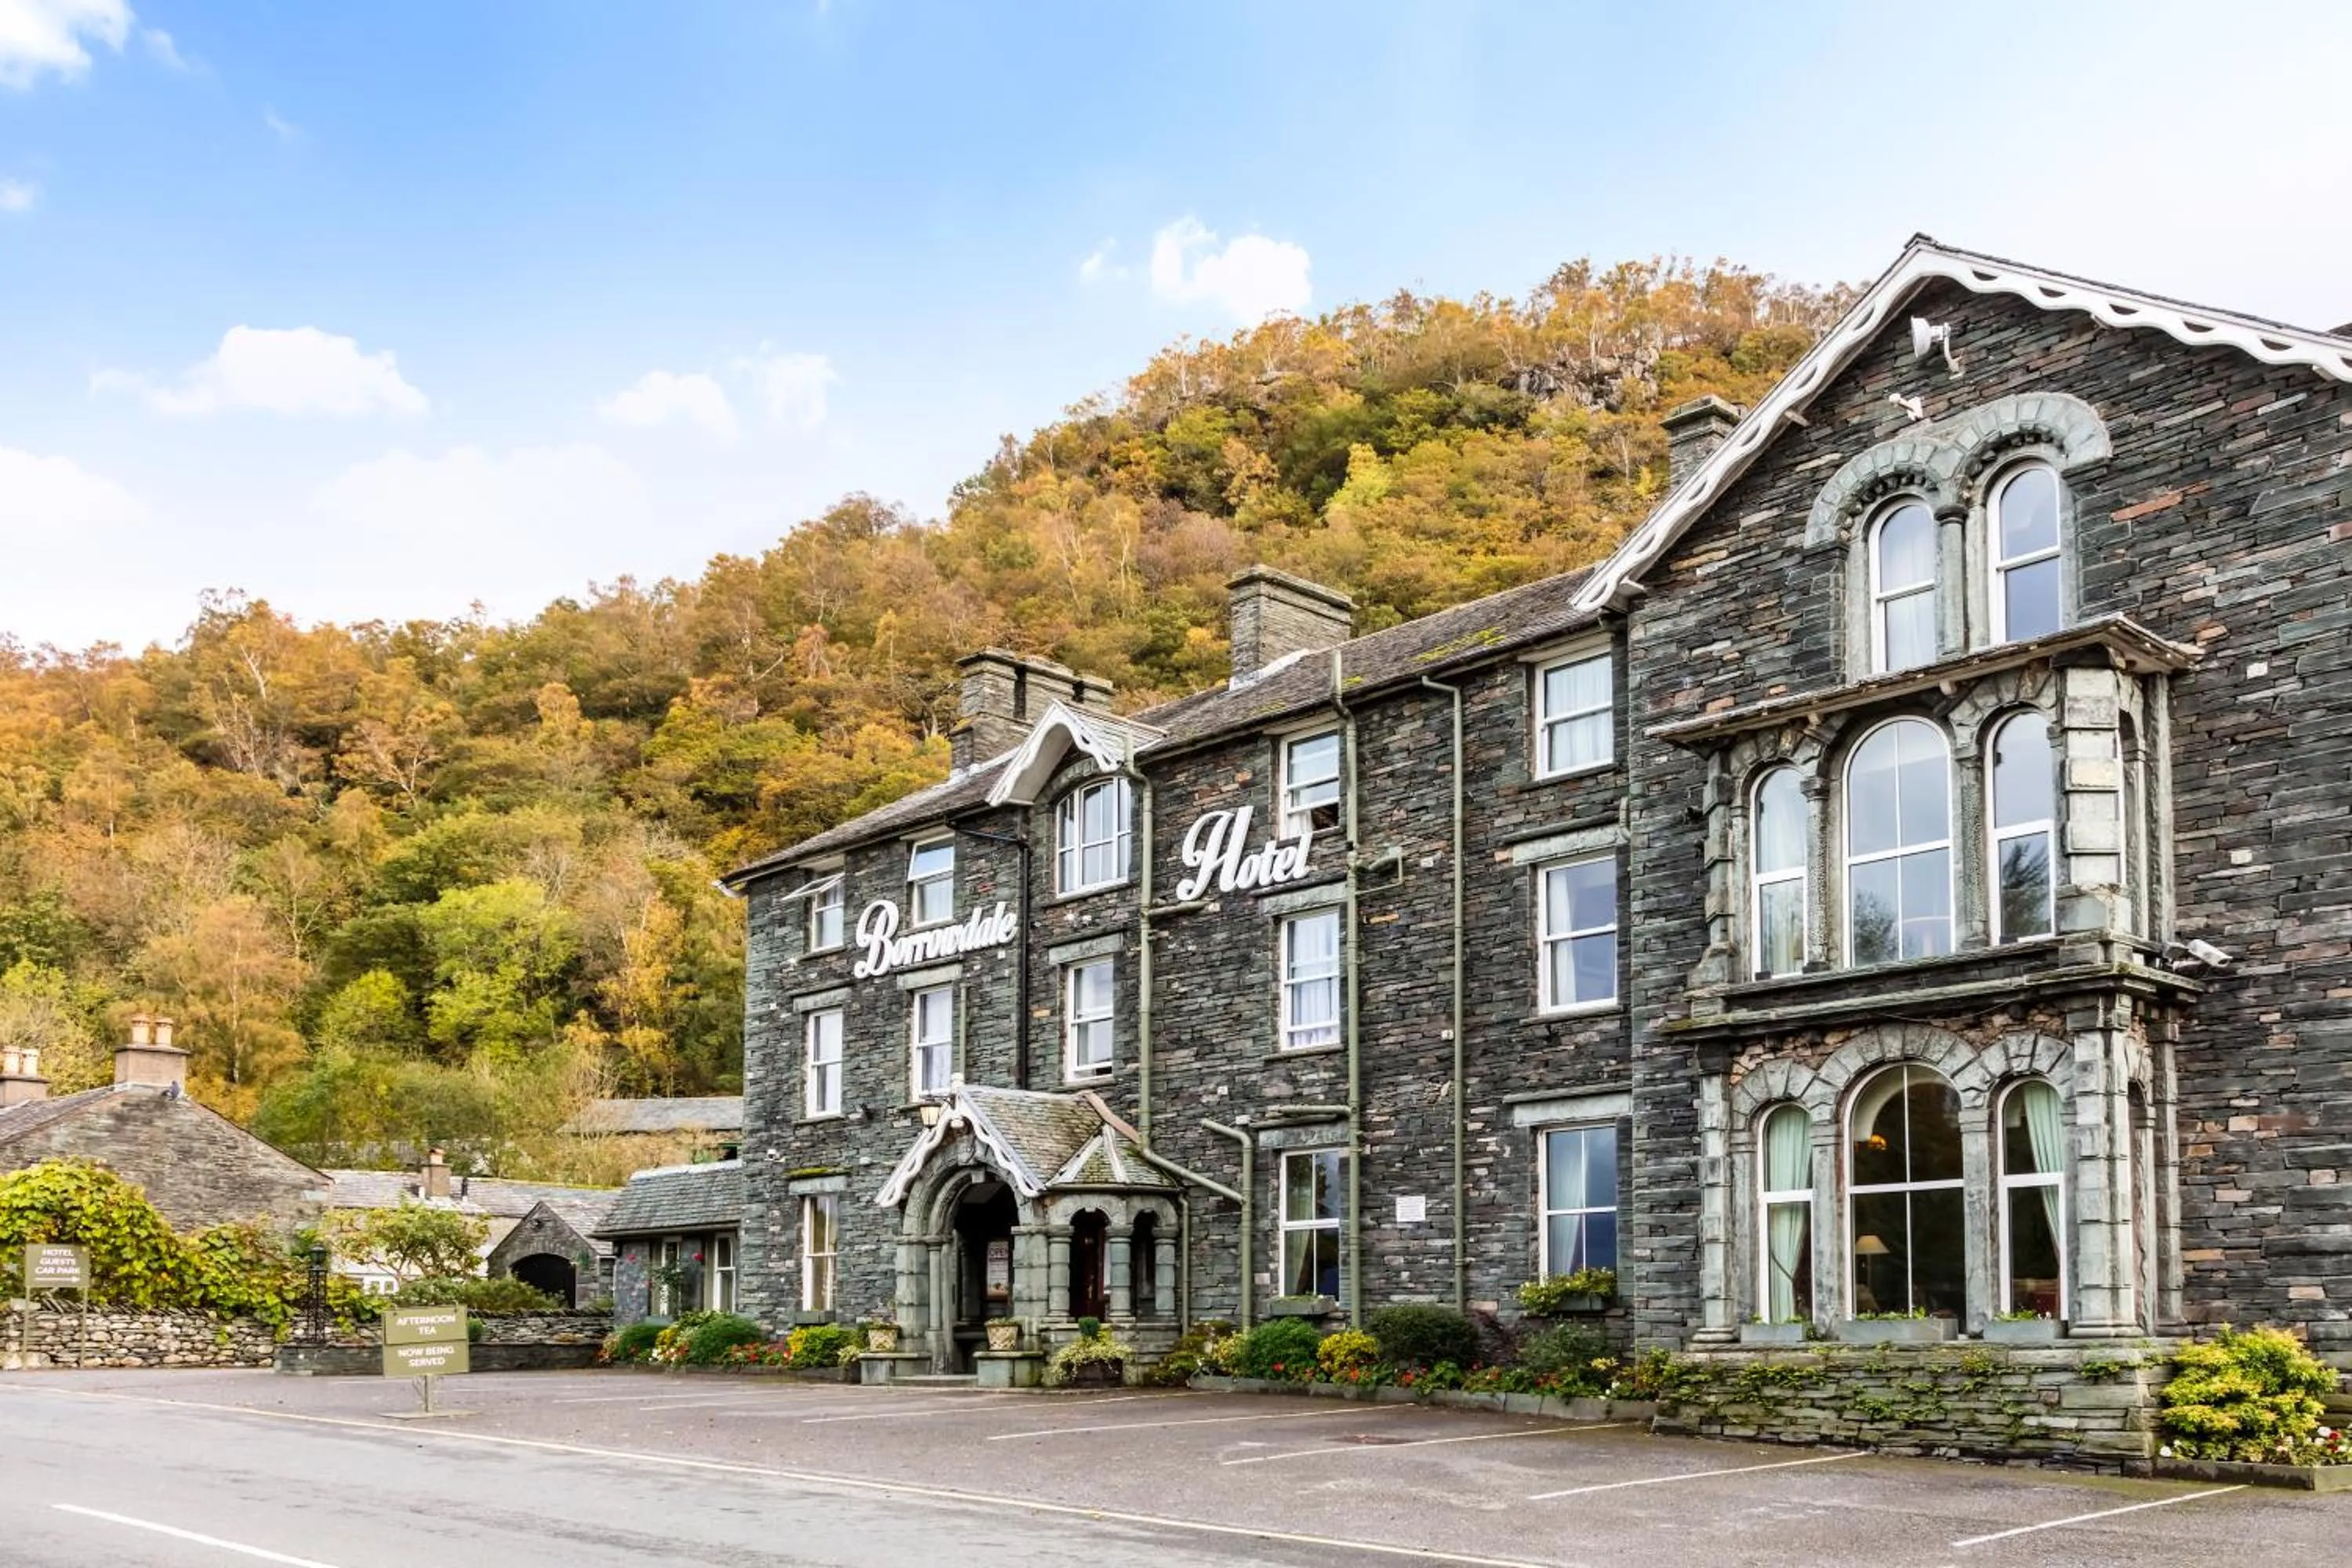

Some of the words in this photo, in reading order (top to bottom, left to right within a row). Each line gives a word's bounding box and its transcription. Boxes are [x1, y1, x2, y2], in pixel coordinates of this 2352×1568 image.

[854, 899, 1018, 979] Borrowdale
[1177, 805, 1312, 901] Hotel
[396, 1315, 456, 1326] AFTERNOON
[419, 1326, 437, 1334] TEA
[397, 1347, 424, 1357] NOW
[426, 1345, 455, 1356] BEING
[408, 1356, 446, 1367] SERVED
